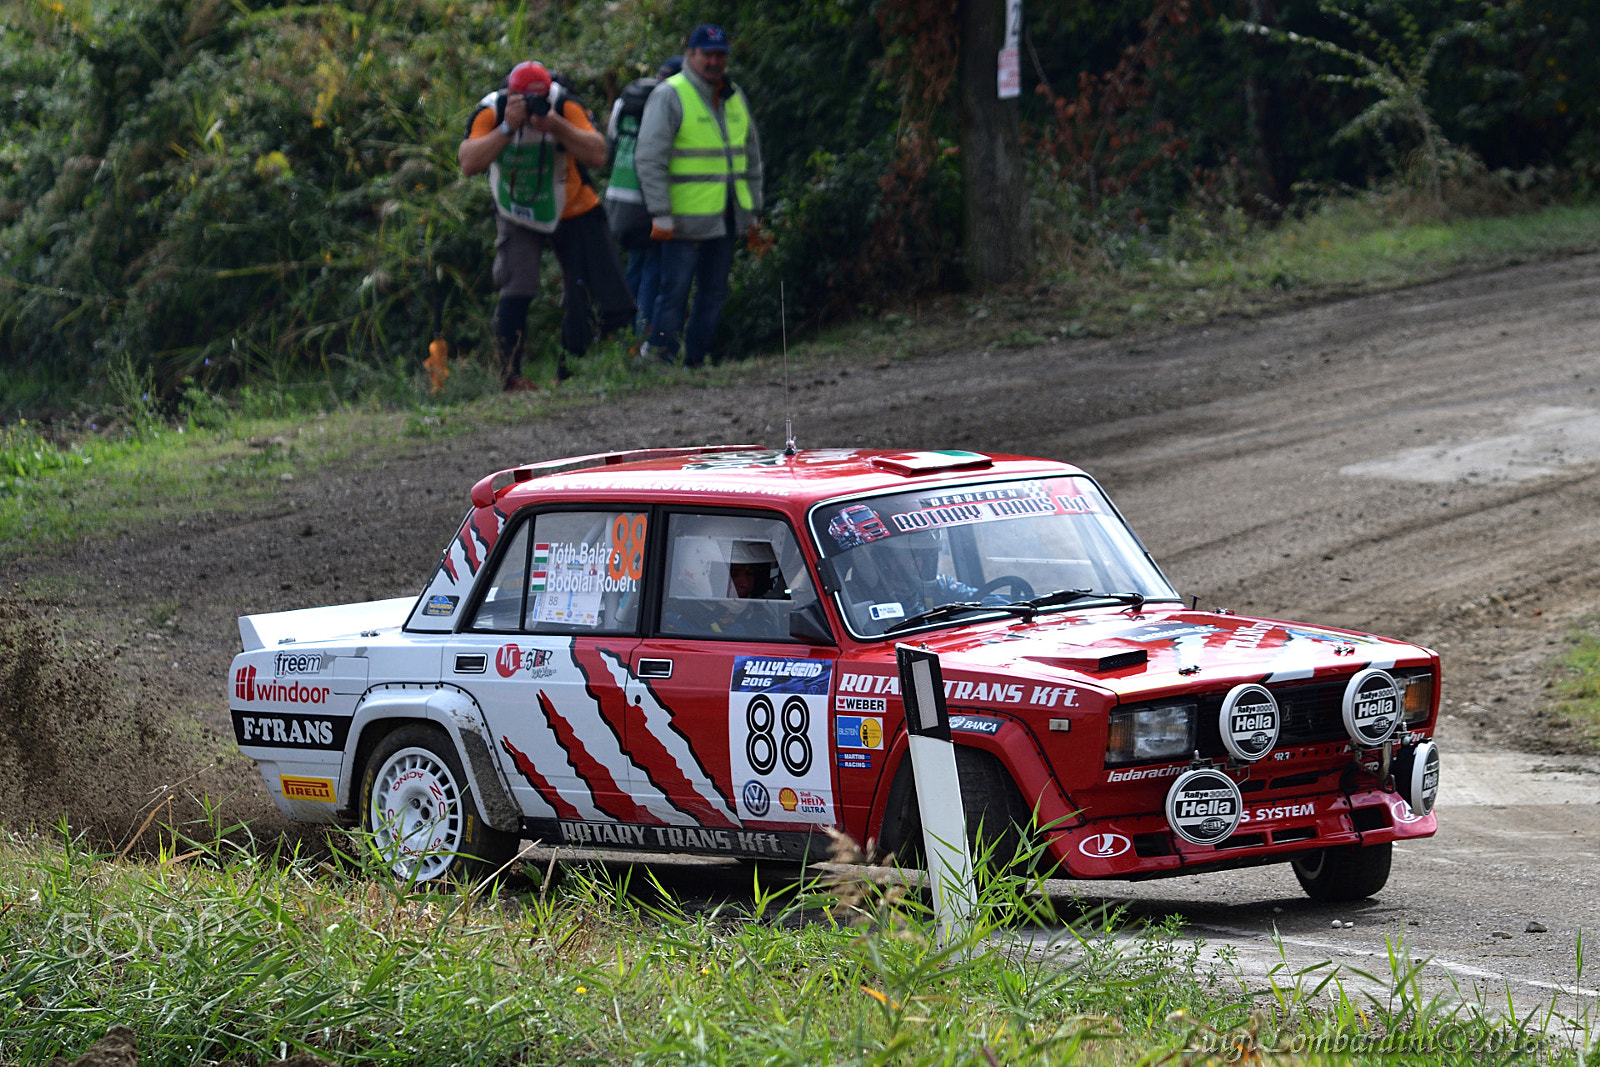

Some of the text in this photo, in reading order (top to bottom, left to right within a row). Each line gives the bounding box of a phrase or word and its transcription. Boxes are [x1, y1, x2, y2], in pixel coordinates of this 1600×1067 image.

[893, 504, 982, 531] ROTARY
[986, 497, 1057, 517] TRANS
[550, 542, 620, 565] Tóth Balázs
[608, 514, 648, 582] 88
[546, 570, 593, 592] Bodolai
[276, 652, 321, 676] freem
[744, 660, 823, 678] RALLYLEGEND
[741, 677, 772, 687] 2016
[838, 672, 1080, 708] ROTA TRANS Kft.
[256, 680, 330, 704] windoor
[846, 698, 884, 711] WEBER
[1357, 699, 1394, 718] Hella
[242, 716, 334, 745] F-TRANS
[963, 720, 997, 733] BANCA
[1235, 714, 1272, 731] Hella
[746, 693, 813, 778] 88
[283, 779, 330, 798] PIRELLI
[1184, 789, 1233, 799] Rallye 3000
[800, 797, 825, 806] HELIX
[801, 806, 826, 814] ULTRA
[1181, 800, 1231, 817] Hella
[1255, 803, 1315, 821] SYSTEM
[559, 821, 787, 854] ROTARY TRANS Kft.
